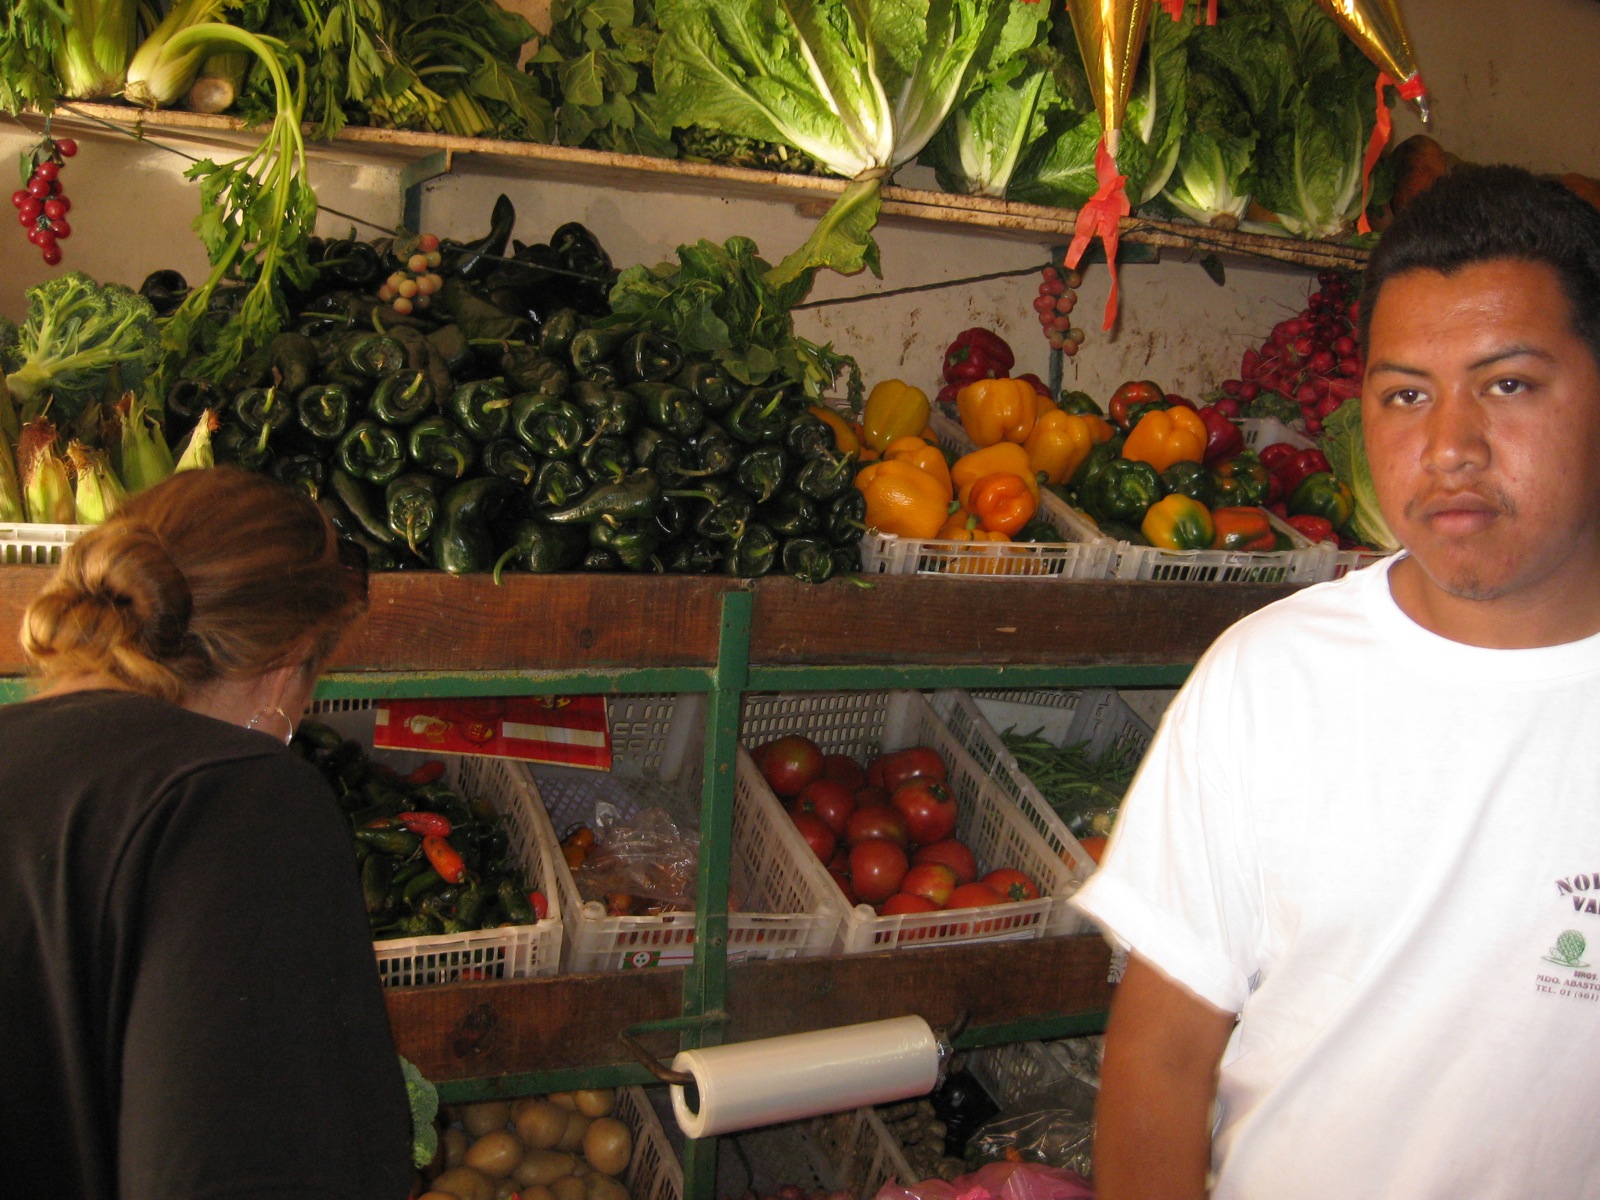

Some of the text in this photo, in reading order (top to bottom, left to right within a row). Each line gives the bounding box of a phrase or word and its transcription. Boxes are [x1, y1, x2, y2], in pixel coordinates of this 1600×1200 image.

[1572, 895, 1600, 915] VA
[1536, 974, 1560, 984] MDO.
[1536, 984, 1556, 994] TEL.
